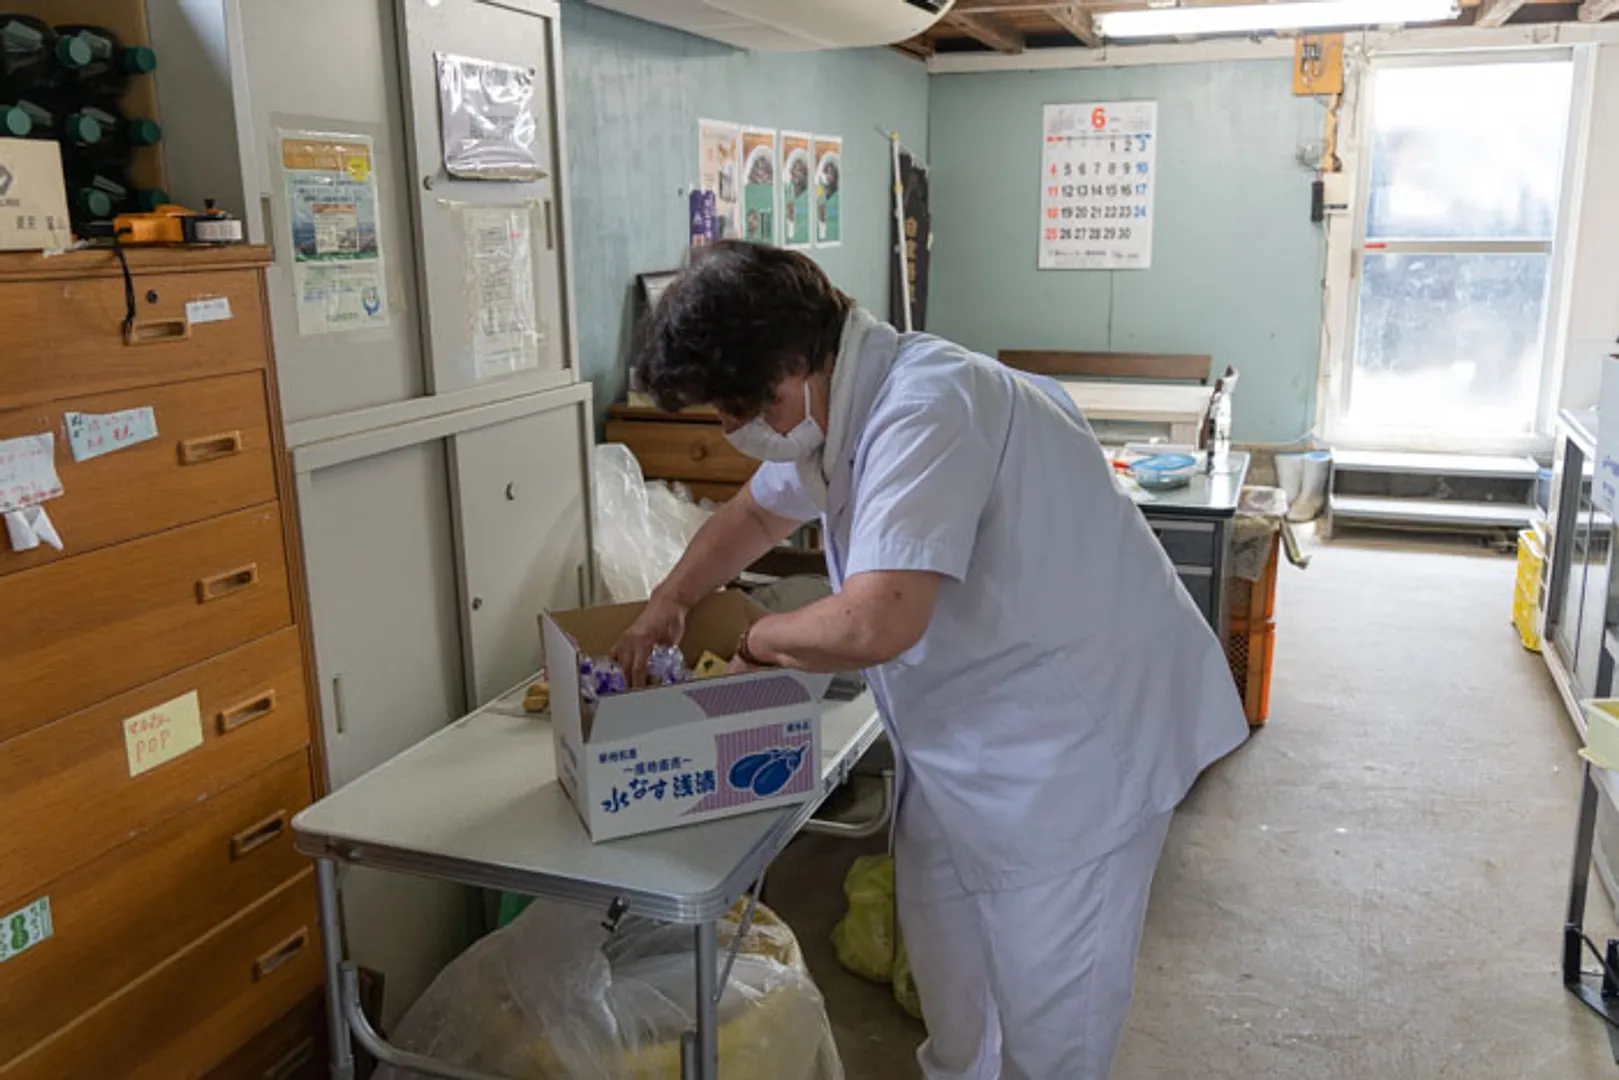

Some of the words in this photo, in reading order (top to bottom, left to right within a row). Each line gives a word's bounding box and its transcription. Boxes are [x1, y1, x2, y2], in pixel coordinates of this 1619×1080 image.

[1091, 106, 1107, 129] 6
[1110, 140, 1116, 152] 1
[1124, 140, 1133, 152] 2
[1049, 163, 1057, 176] 4
[1064, 163, 1072, 176] 5
[1078, 162, 1087, 175] 6
[1093, 162, 1101, 175] 7
[1108, 162, 1116, 175] 8
[1123, 162, 1131, 175] 9
[1135, 162, 1149, 174] 10
[1048, 185, 1059, 196] 11
[1062, 185, 1074, 197] 12
[1076, 184, 1088, 196] 13
[1091, 184, 1102, 196] 14
[1105, 184, 1117, 196] 15
[1120, 184, 1132, 196] 16
[1135, 183, 1147, 195] 17
[1047, 207, 1058, 219] 18
[1061, 206, 1073, 218] 19
[1075, 206, 1088, 218] 20
[1090, 206, 1102, 218] 21
[1104, 206, 1117, 218] 22
[1119, 206, 1131, 218] 23
[1133, 205, 1146, 218] 24
[1045, 228, 1057, 240] 25
[1059, 228, 1072, 240] 26
[1074, 228, 1087, 240] 27
[1089, 228, 1101, 240] 28
[1103, 227, 1116, 240] 29
[1118, 227, 1131, 240] 30
